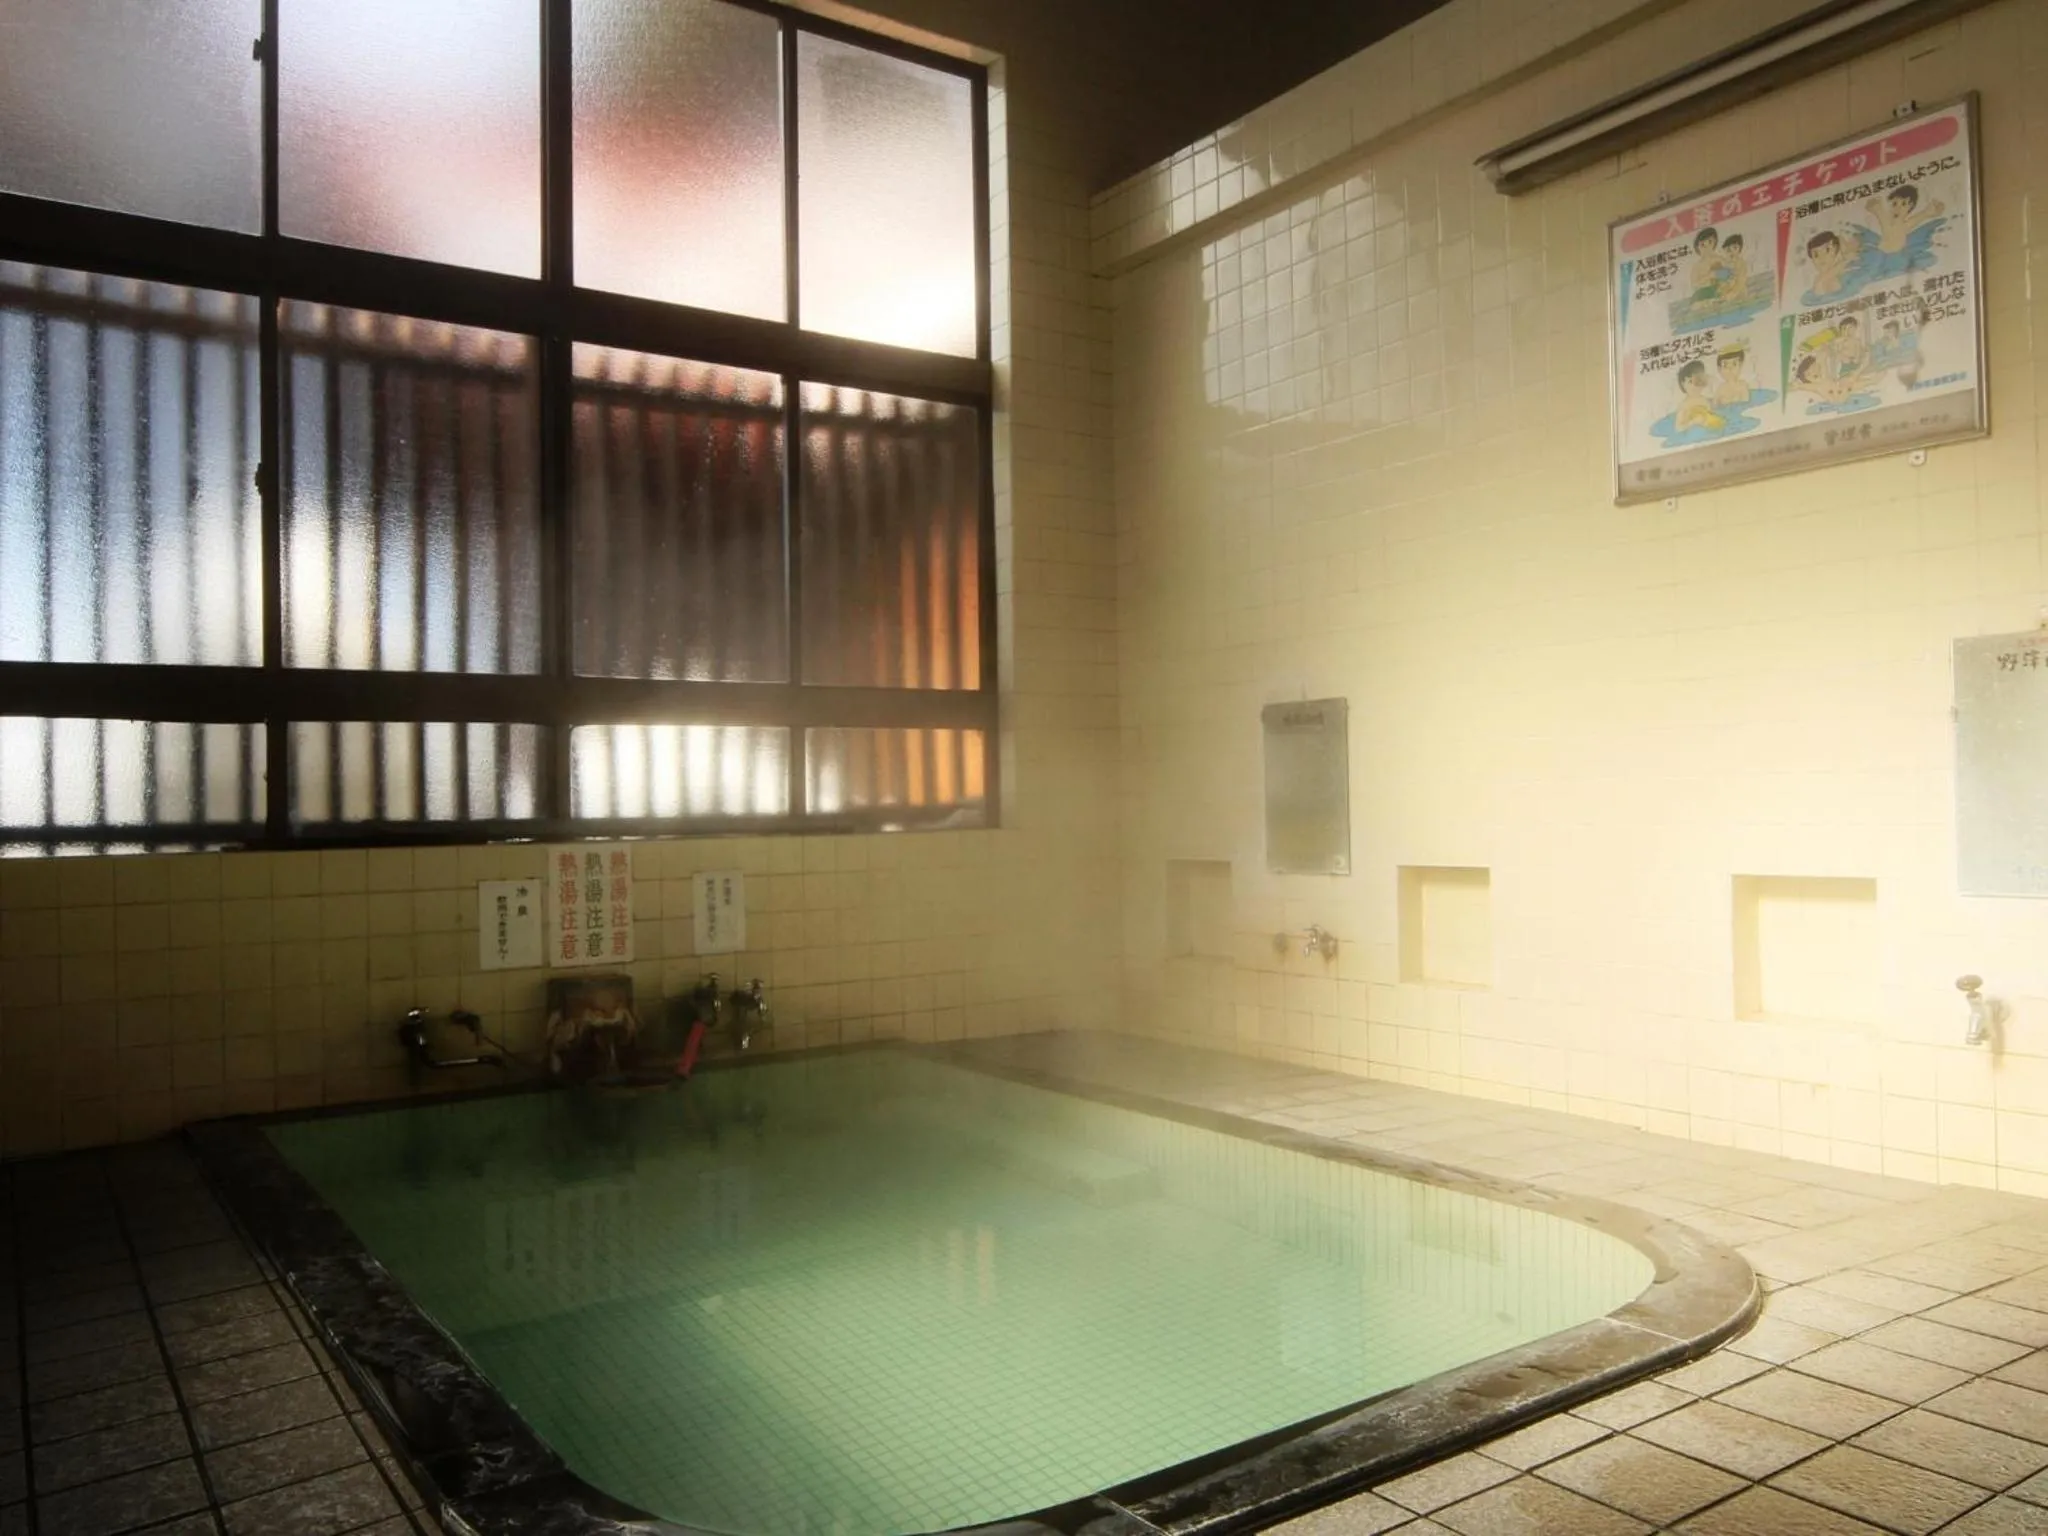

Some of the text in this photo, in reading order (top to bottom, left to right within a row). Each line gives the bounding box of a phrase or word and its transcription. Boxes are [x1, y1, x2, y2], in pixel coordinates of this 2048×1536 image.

[1664, 142, 1897, 239] 入浴のエチケット
[1636, 263, 1679, 284] 体を洗う
[1876, 286, 1966, 321] まま出りしな
[584, 851, 604, 957] 熱湯注意
